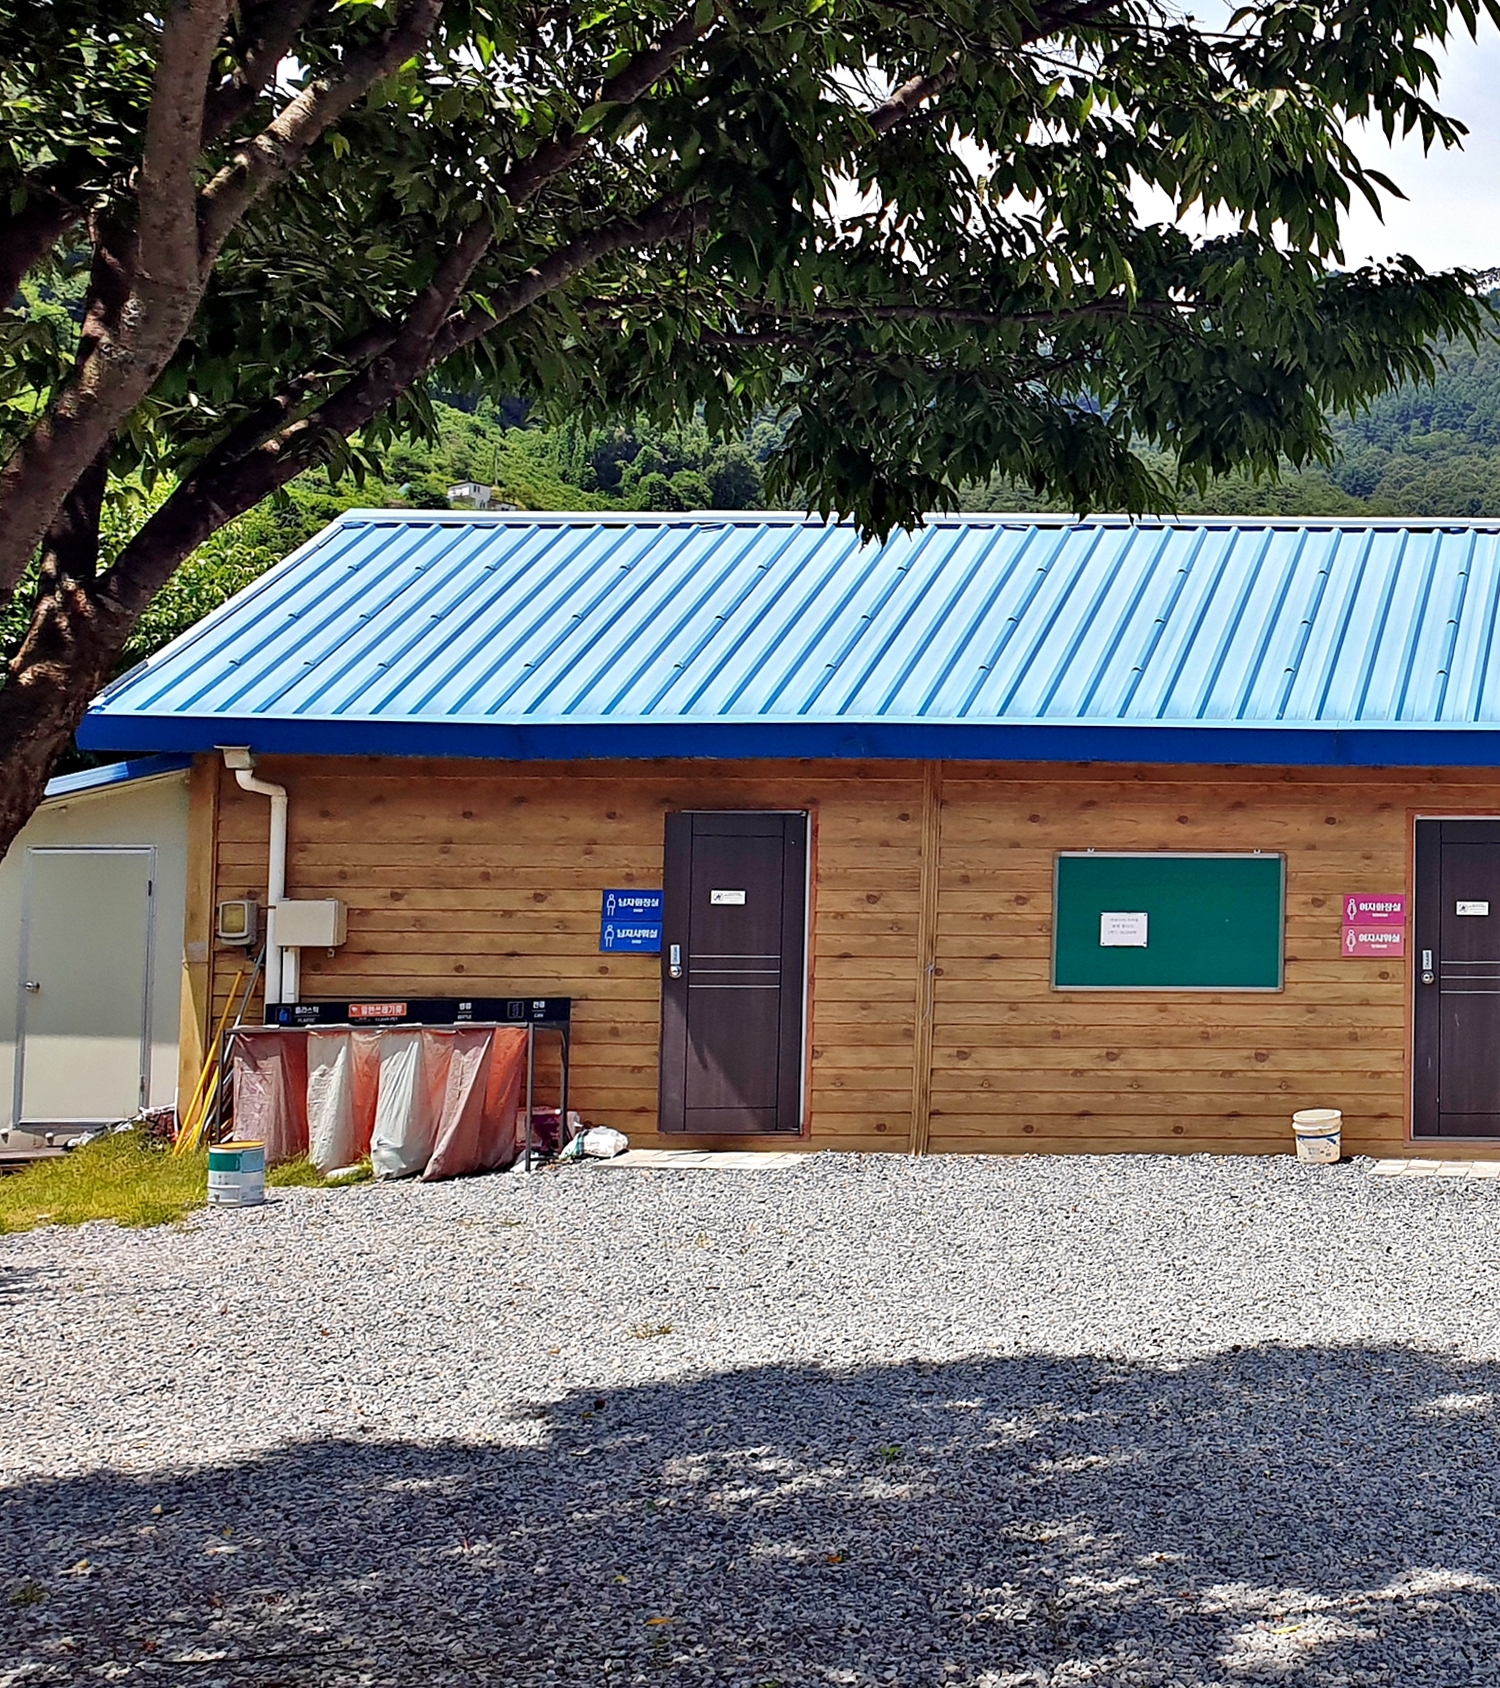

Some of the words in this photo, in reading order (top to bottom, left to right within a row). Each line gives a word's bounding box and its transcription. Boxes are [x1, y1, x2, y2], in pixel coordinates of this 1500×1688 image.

[618, 898, 659, 907] 남자화장실
[1359, 902, 1401, 912] 여자화장실
[617, 929, 658, 938] 남자샤워실
[1358, 933, 1400, 943] 여자샤워실
[295, 1006, 320, 1015] 플라스틱
